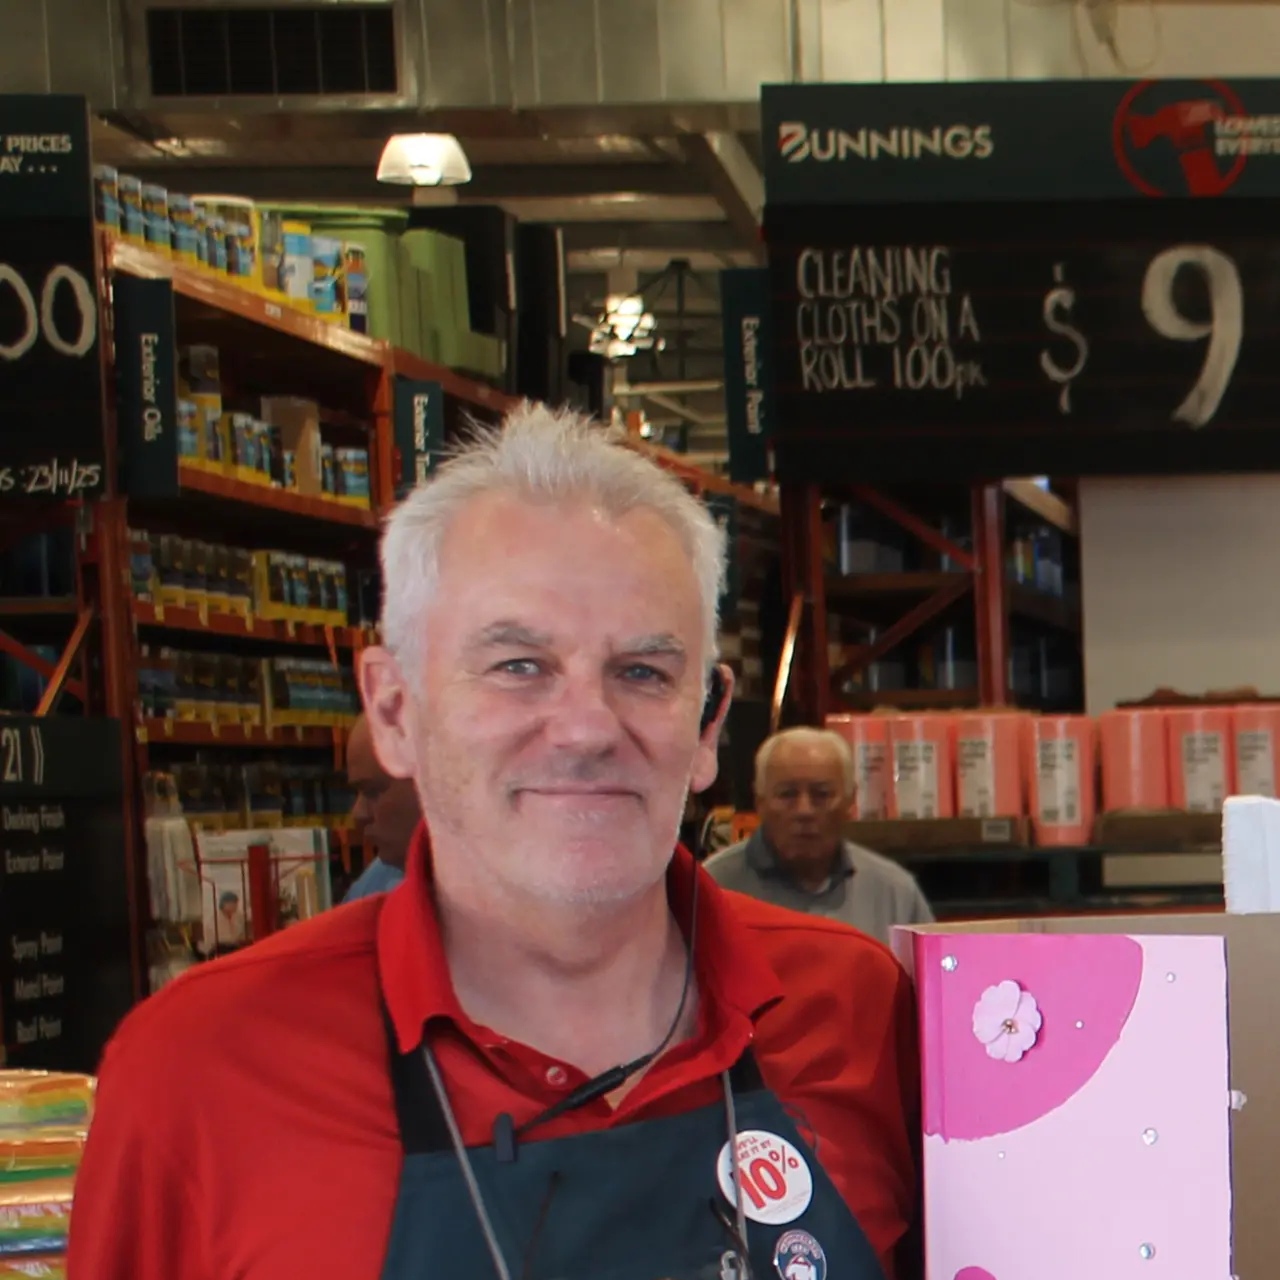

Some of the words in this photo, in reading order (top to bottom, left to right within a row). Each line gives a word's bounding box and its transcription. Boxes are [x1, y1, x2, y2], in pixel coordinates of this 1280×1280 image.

[7, 135, 72, 152] PRICES
[779, 121, 993, 162] BUNNINGS
[797, 246, 952, 299] CLEANING
[797, 297, 900, 346] CLOTHS
[912, 296, 949, 343] ON
[959, 292, 980, 342] A
[1040, 261, 1089, 414] $
[1140, 244, 1244, 431] 9
[140, 332, 160, 404] Exterior
[801, 341, 877, 393] ROLL
[730, 1145, 799, 1210] 10%
